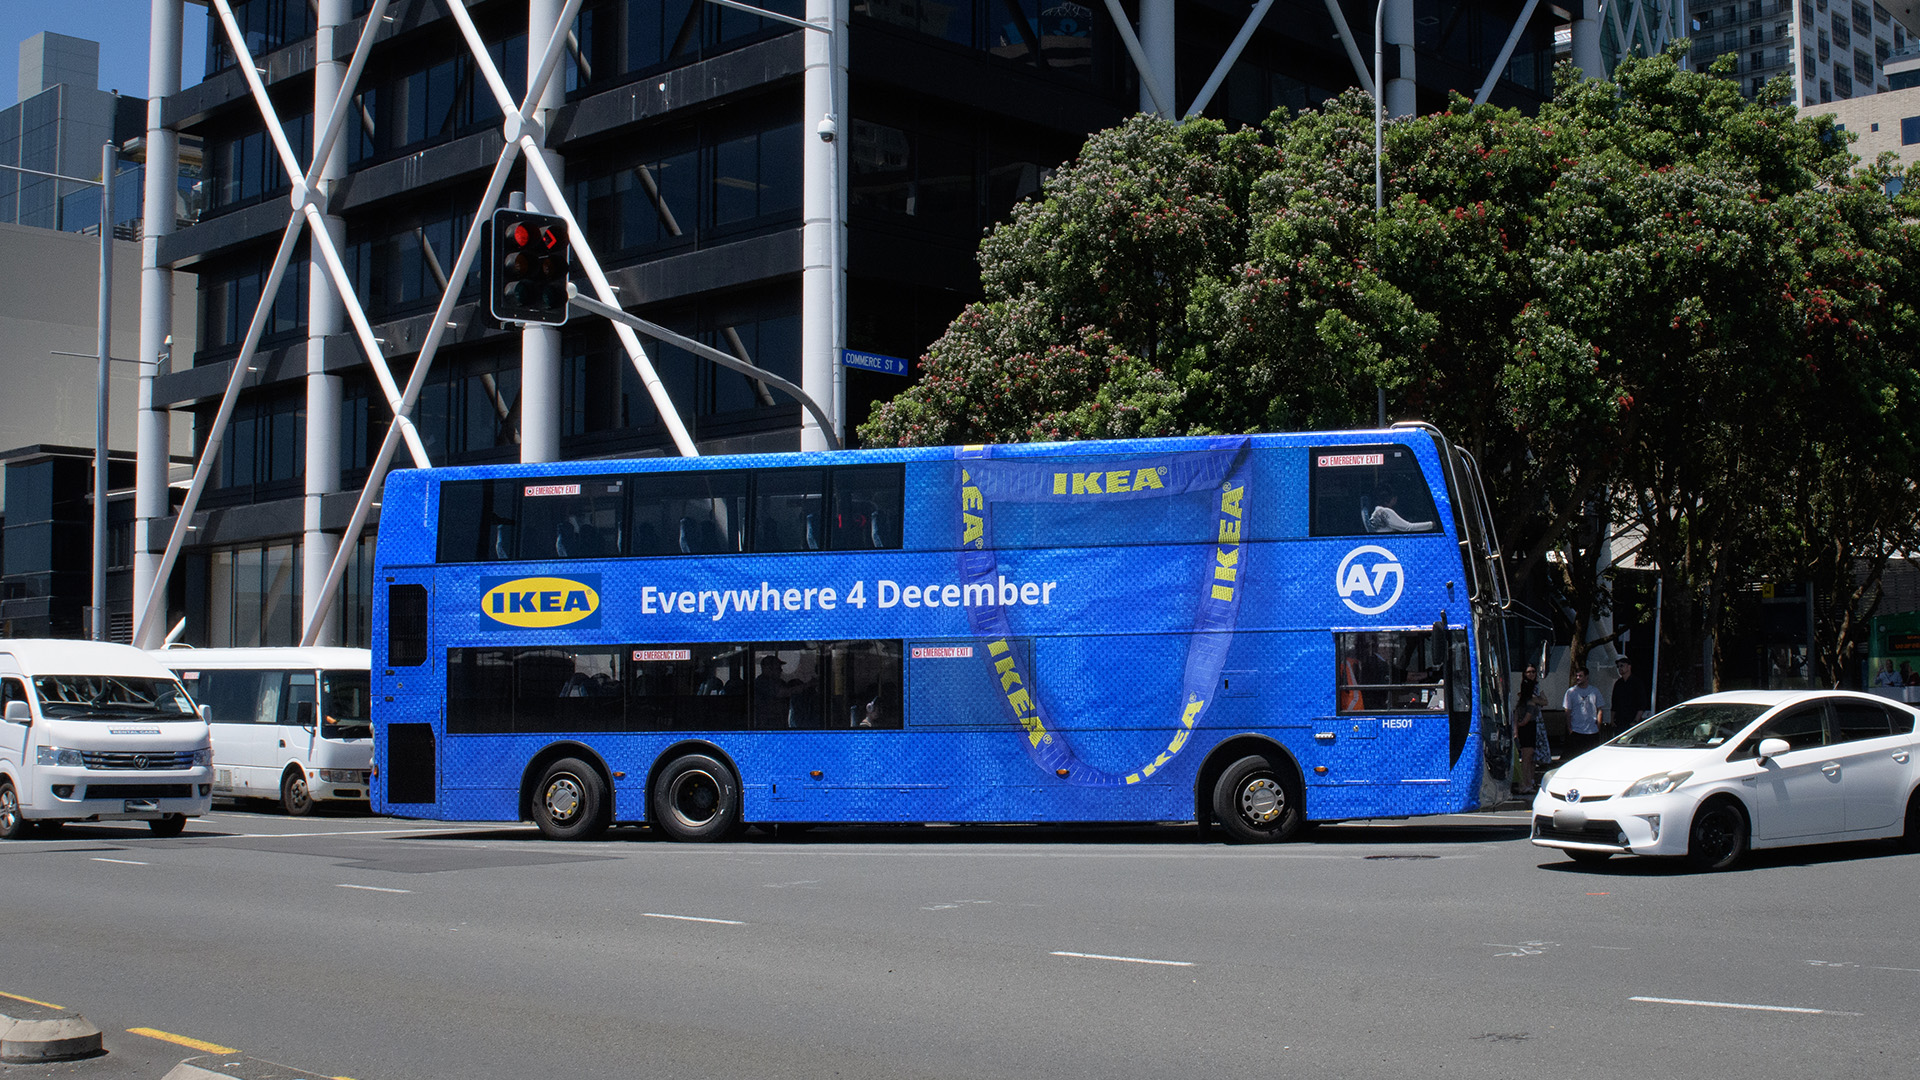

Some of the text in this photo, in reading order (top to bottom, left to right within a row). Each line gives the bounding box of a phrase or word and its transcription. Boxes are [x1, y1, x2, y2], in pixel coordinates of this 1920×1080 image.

[845, 353, 894, 370] COMMERCE ST
[1330, 455, 1379, 465] EMERGENCY EXIT
[535, 485, 577, 495] EMERGENCY EXIT
[641, 575, 1057, 621] Everywhere 4 December
[644, 651, 687, 659] EMERGENCY EXIT
[923, 648, 969, 657] EMERGENCY EXIT
[1382, 719, 1412, 729] HE501
